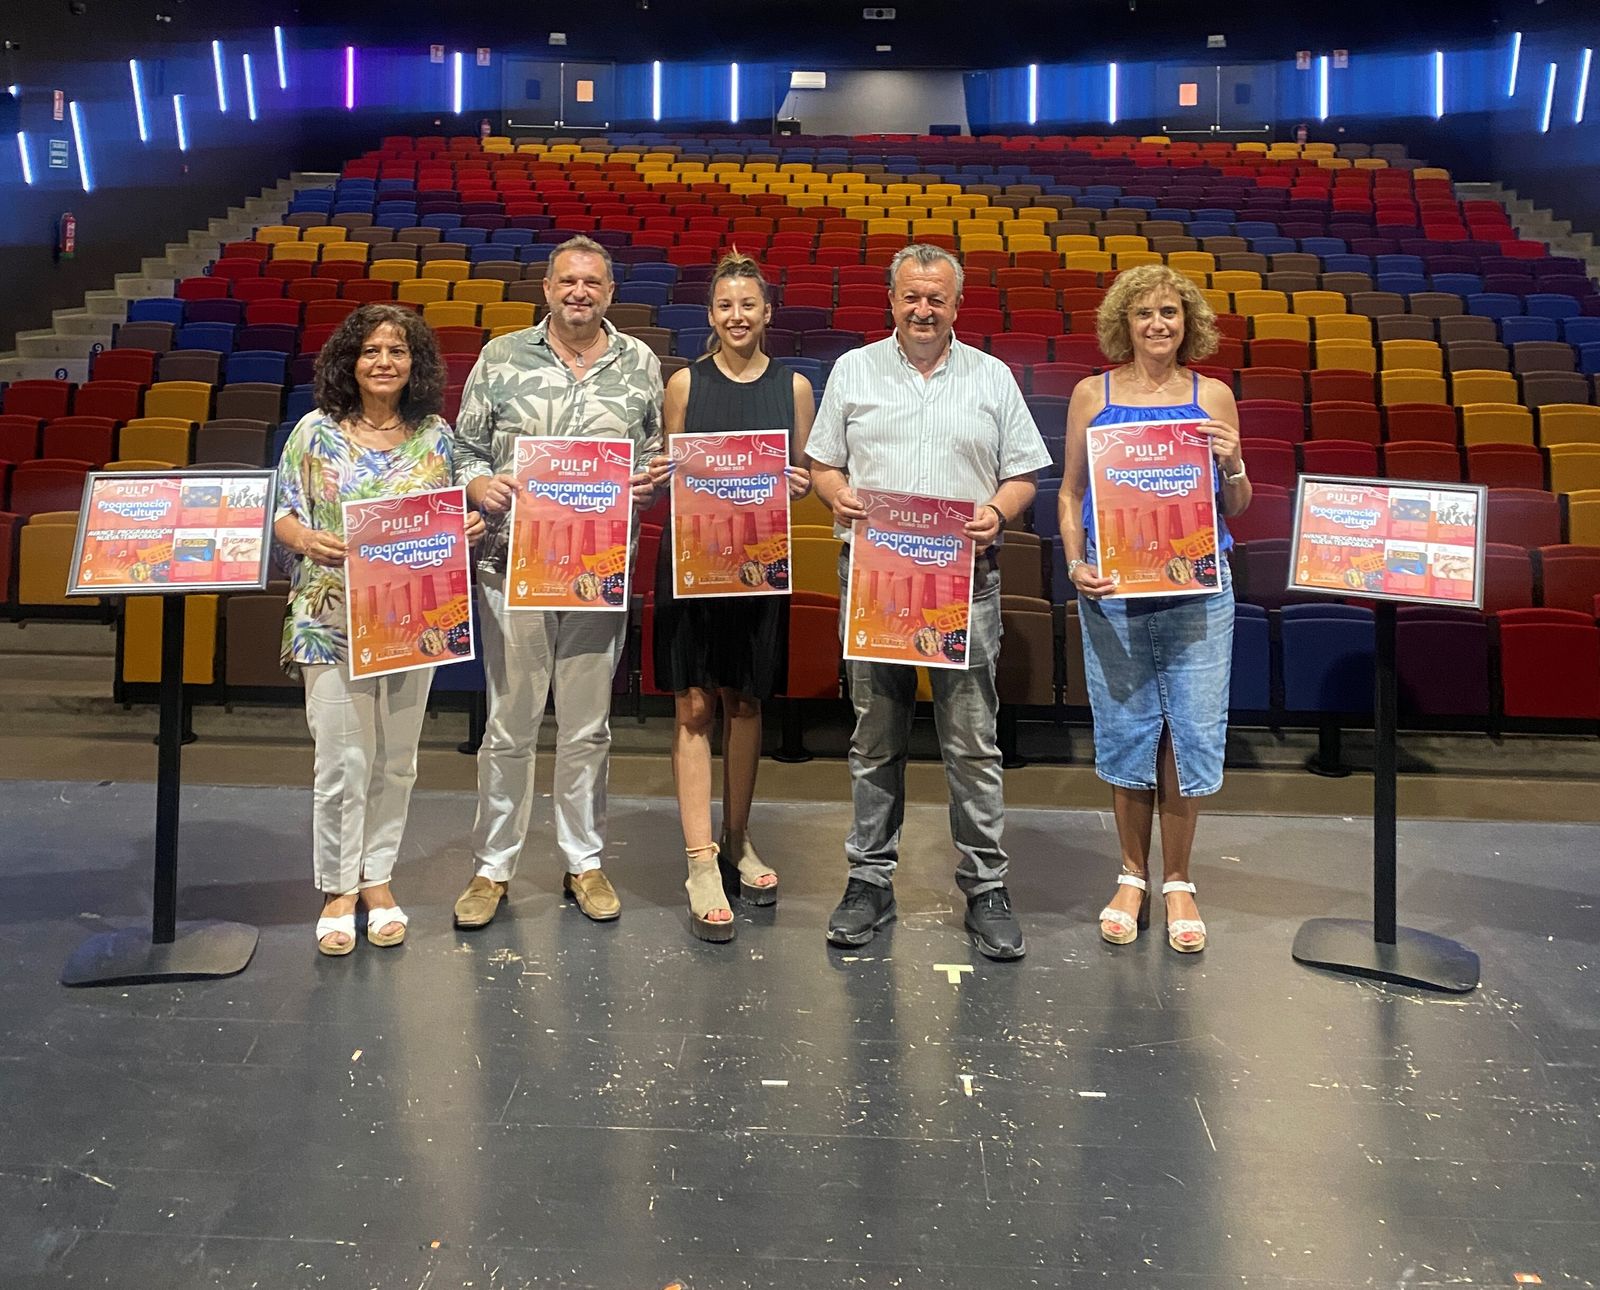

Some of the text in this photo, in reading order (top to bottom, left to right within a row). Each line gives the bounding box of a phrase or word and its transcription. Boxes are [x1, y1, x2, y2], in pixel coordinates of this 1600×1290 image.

[95, 344, 102, 353] 9
[58, 369, 64, 379] 8
[1125, 441, 1174, 457] PULPÍ
[550, 457, 599, 472] PULPÍ
[705, 451, 753, 467] PULPÍ
[686, 474, 777, 494] Programación
[1106, 465, 1201, 487] Programación
[116, 485, 155, 495] PULPÍ
[528, 479, 620, 500] Programación
[716, 486, 773, 505] Cultural
[1139, 479, 1198, 497] Cultural
[558, 492, 616, 513] Cultural
[1327, 492, 1364, 503] PULPÍ
[97, 499, 172, 514] Programación
[120, 508, 167, 521] Cultural
[1310, 505, 1381, 520] Programación
[381, 511, 431, 533] PULPÍ
[889, 509, 939, 525] PULPÍ
[1332, 514, 1377, 530] Cultural
[867, 528, 963, 550] Programación
[360, 534, 456, 561] Programación
[898, 544, 957, 567] Cultural
[392, 545, 453, 569] Cultural
